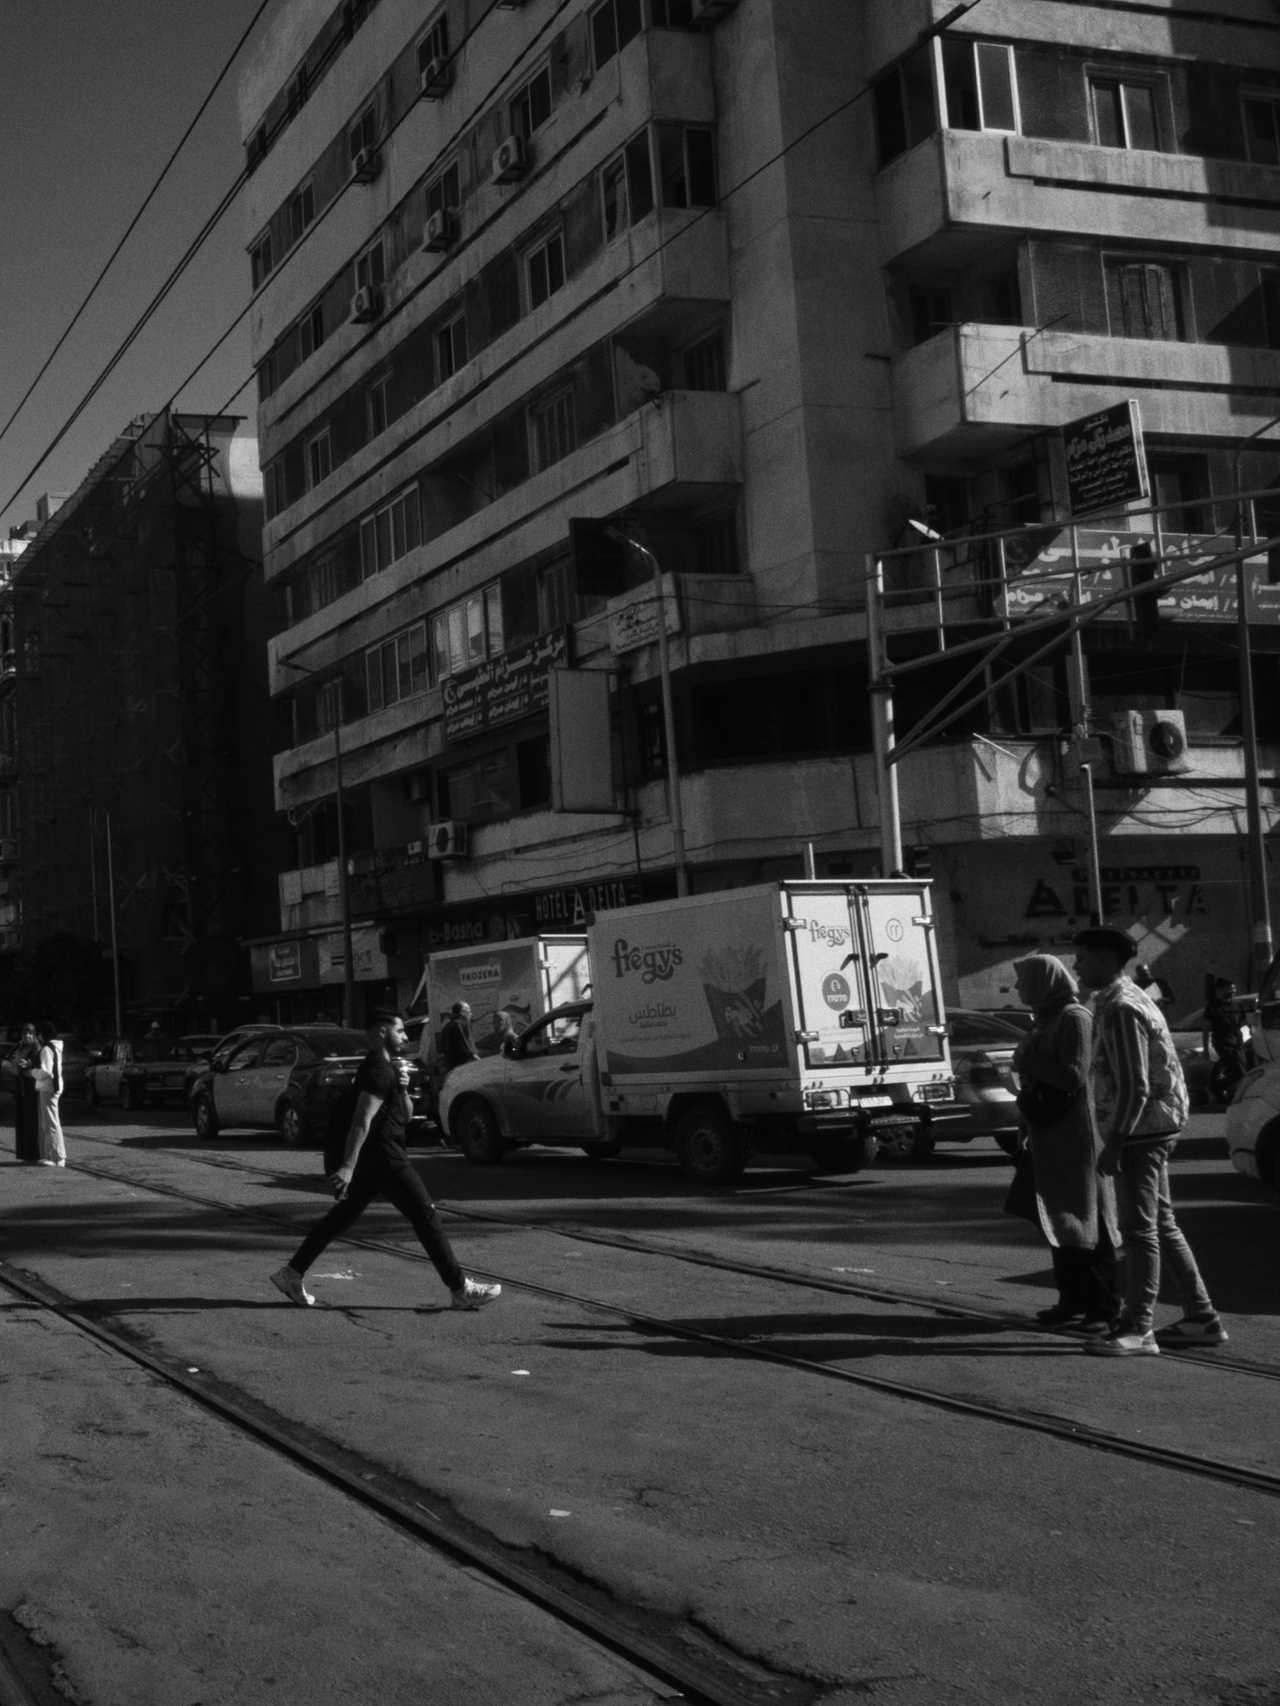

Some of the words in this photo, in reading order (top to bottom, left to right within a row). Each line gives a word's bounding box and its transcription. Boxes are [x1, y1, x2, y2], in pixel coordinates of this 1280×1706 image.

[1077, 867, 1199, 880] Ptisserie
[535, 891, 569, 922] HOTEL
[588, 882, 626, 912] DELTA
[826, 993, 848, 1003] 17070
[628, 1003, 677, 1025] بطاطس
